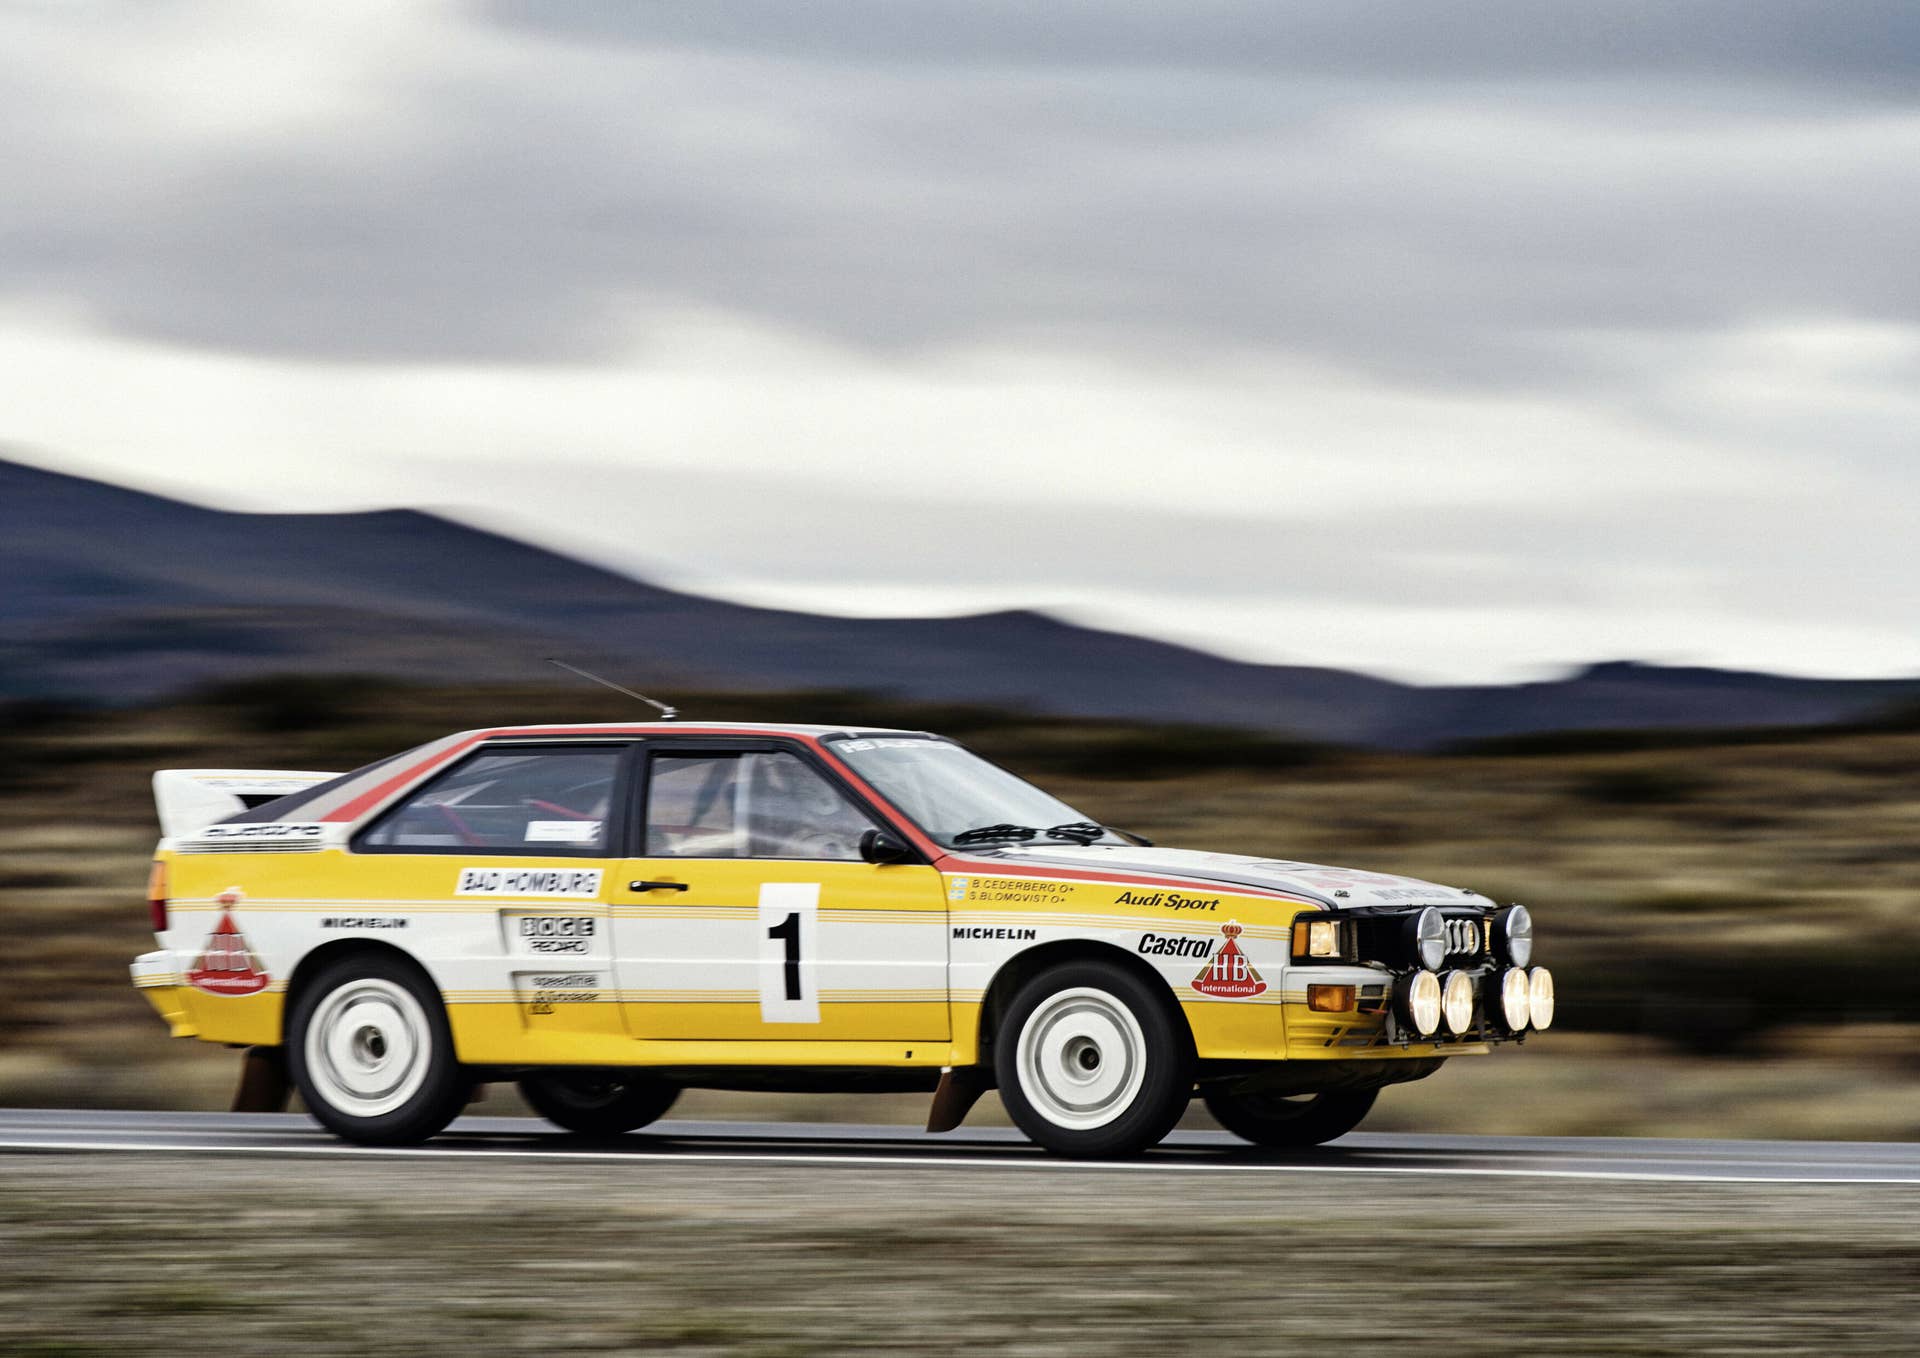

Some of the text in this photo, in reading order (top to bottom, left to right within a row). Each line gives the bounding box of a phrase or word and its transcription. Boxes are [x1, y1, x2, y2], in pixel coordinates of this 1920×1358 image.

[463, 872, 597, 893] BAD HOMBURG
[1114, 891, 1220, 911] Audi Sport
[321, 917, 409, 929] MICHELIN
[521, 917, 594, 936] BOGE
[953, 928, 1037, 940] MICHELIN
[1138, 933, 1214, 958] Castrol
[768, 912, 802, 1001] 1
[1211, 953, 1248, 981] HB
[1201, 982, 1256, 994] international
